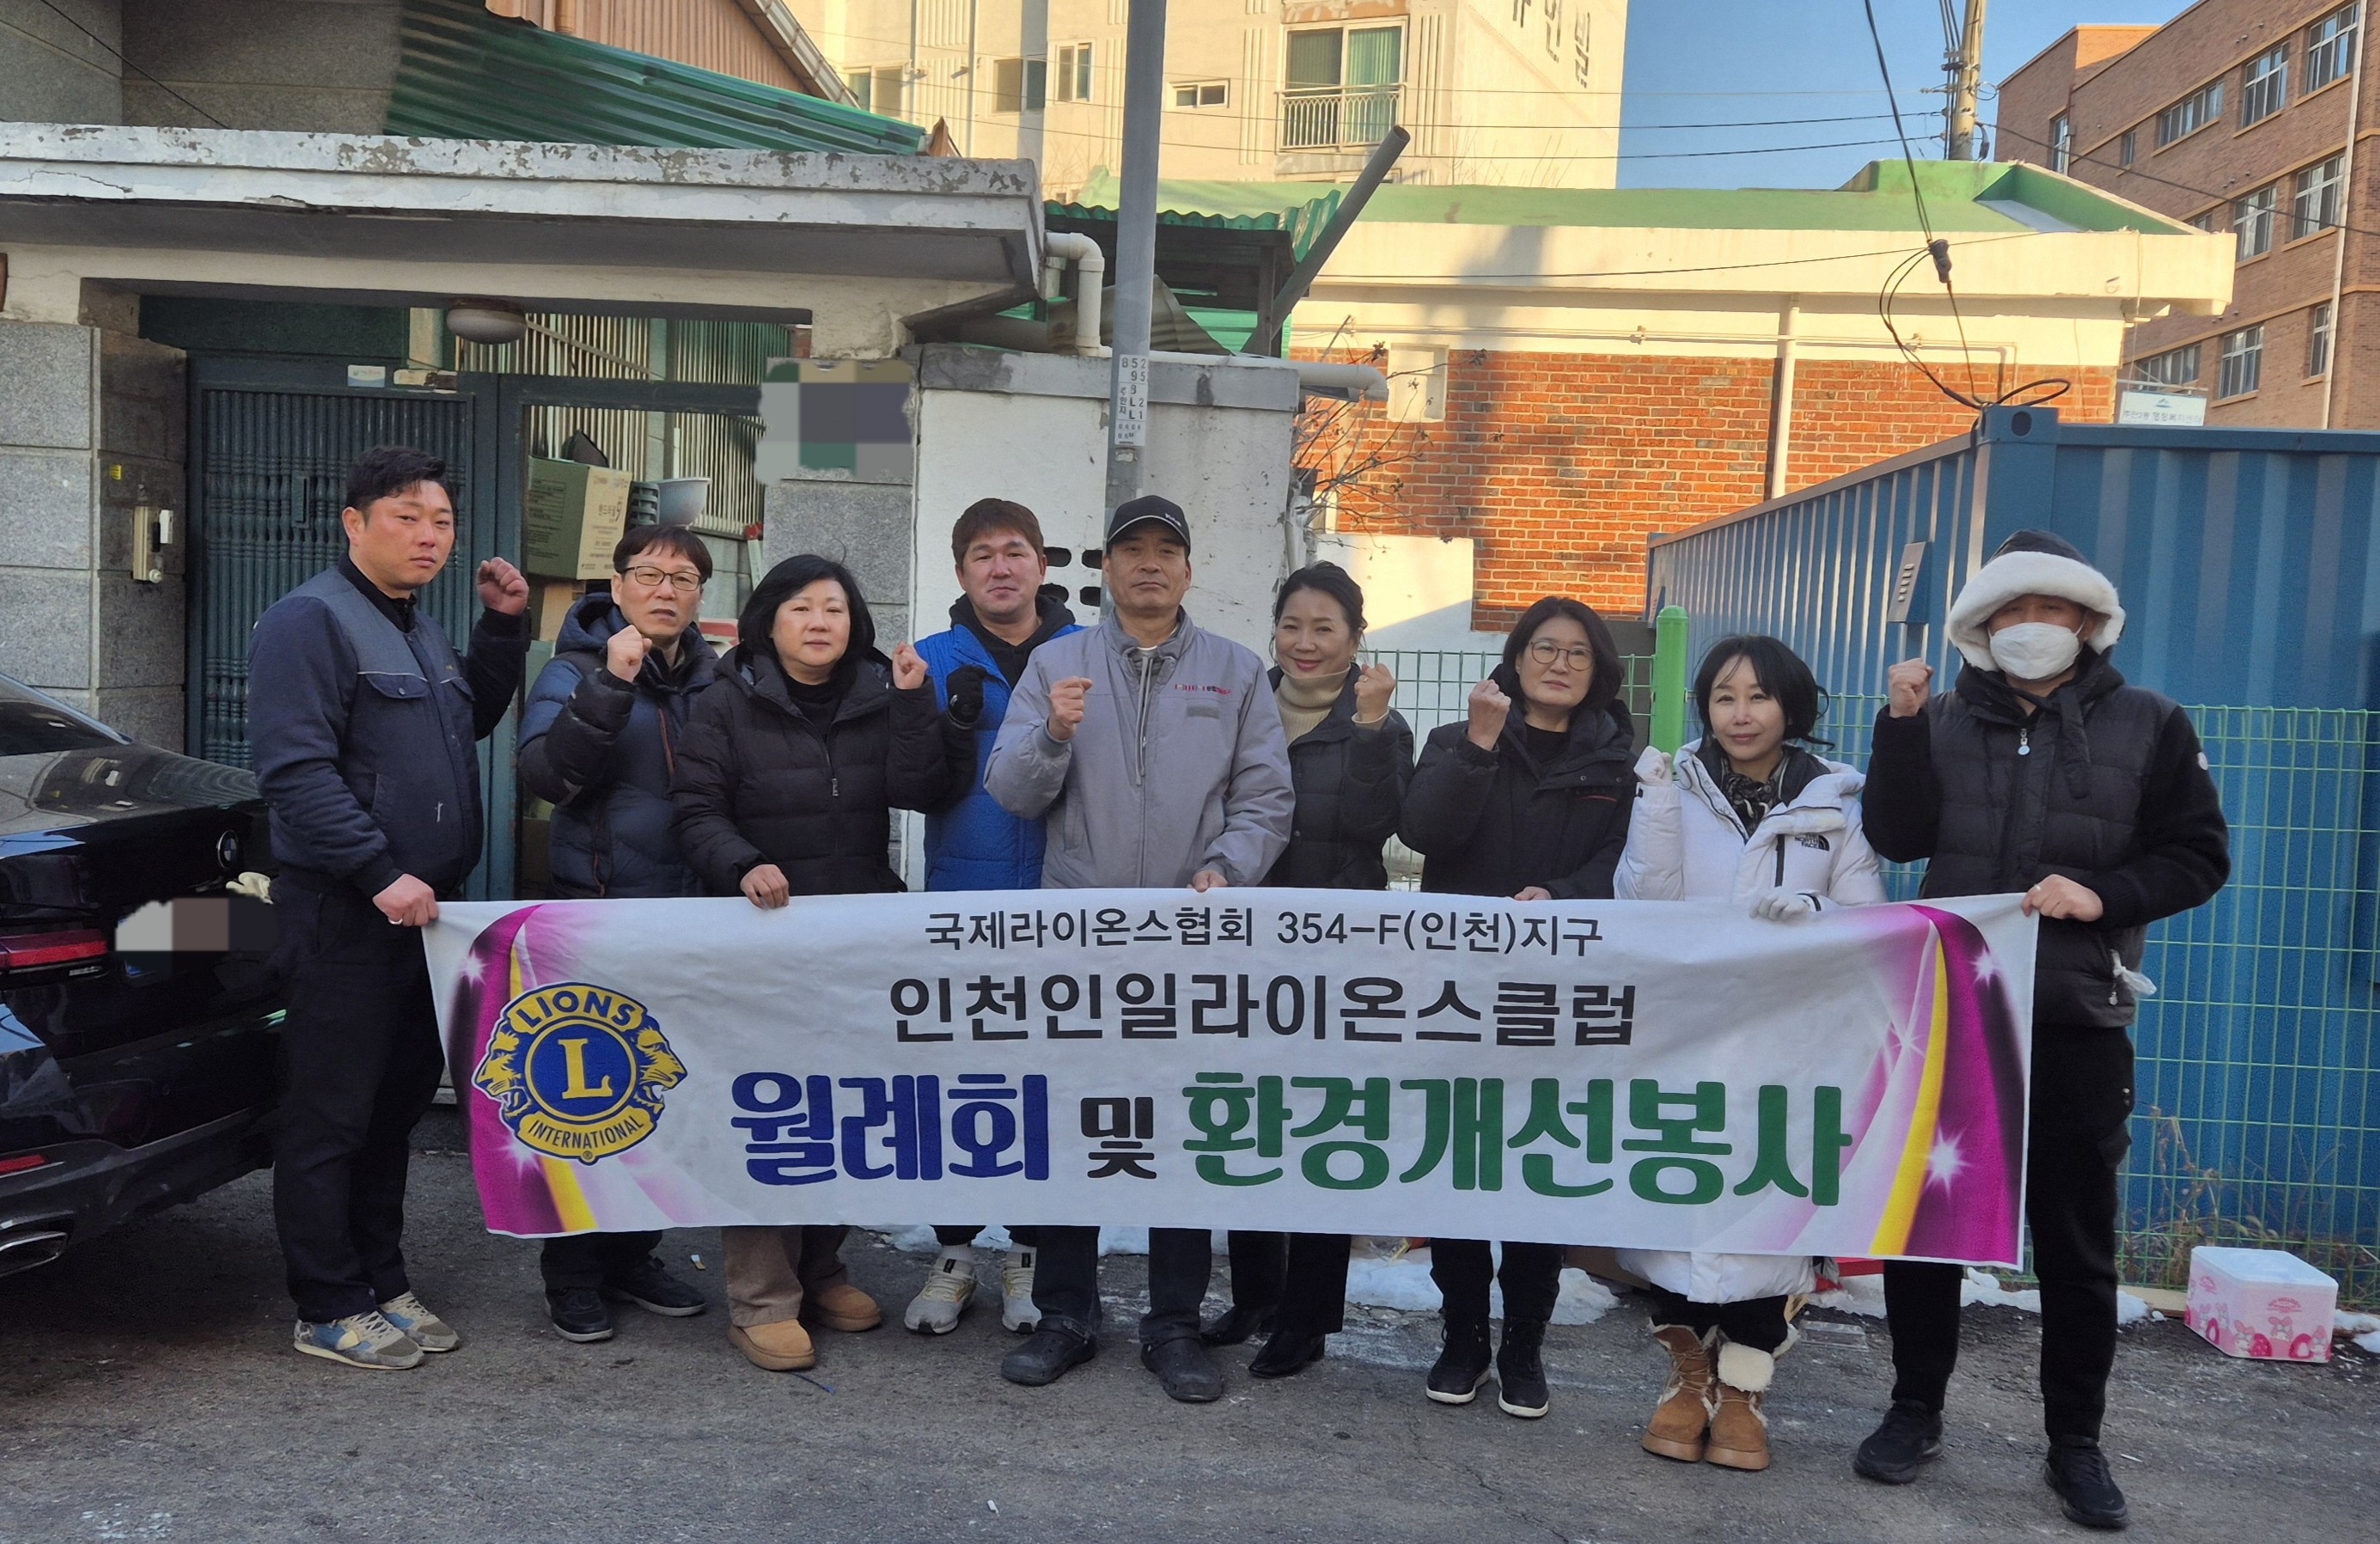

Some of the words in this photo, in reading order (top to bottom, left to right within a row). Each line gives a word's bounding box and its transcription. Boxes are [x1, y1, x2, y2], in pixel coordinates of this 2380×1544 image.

[1121, 357, 1146, 369] 852
[1131, 370, 1145, 382] 95
[925, 906, 1253, 950] 국제라이온스협회
[1277, 909, 1603, 957] 354-F(인천)지구
[516, 991, 637, 1028] LIONS
[892, 973, 1636, 1046] 인천인일라이온스클럽
[558, 1038, 613, 1100] L
[528, 1114, 644, 1150] INTERNATIONAL
[730, 1071, 1049, 1186] 월레회
[1080, 1096, 1157, 1180] 및
[1182, 1071, 1852, 1206] 환경개선봉사
